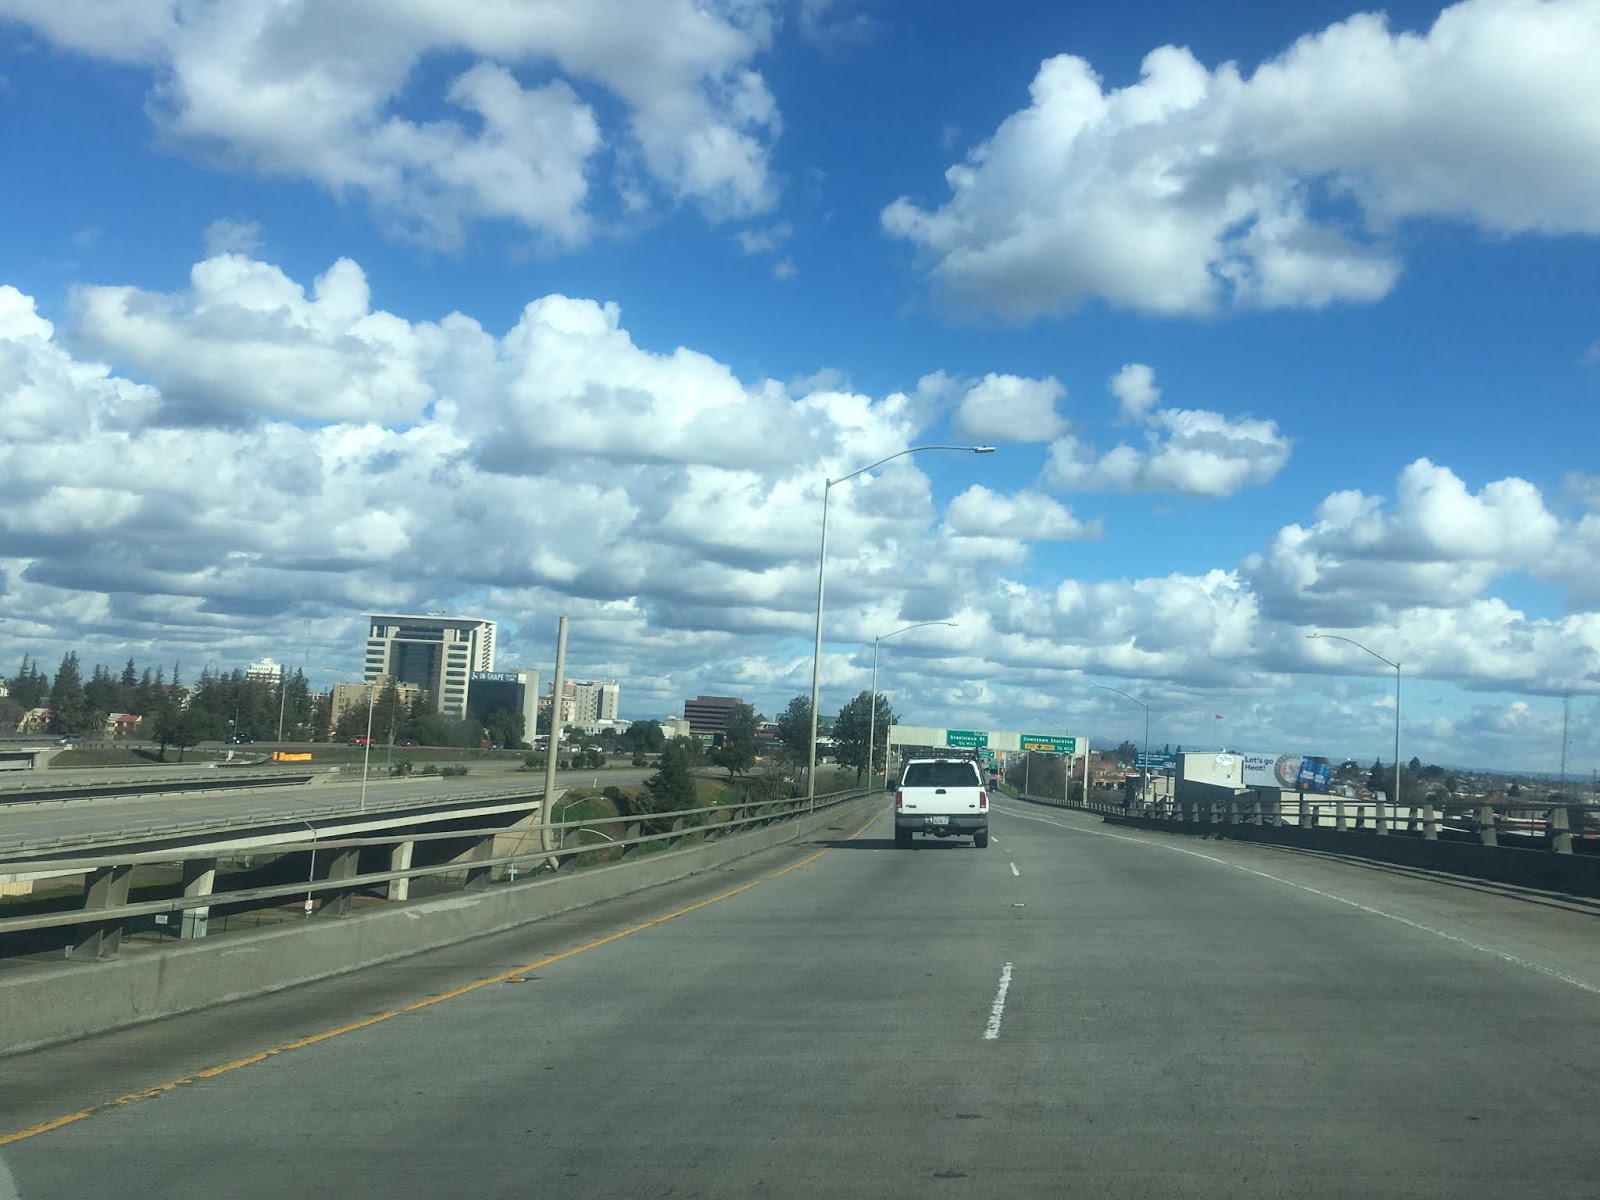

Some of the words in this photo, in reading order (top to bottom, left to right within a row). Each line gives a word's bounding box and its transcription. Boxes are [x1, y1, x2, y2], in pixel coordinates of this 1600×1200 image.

[479, 673, 504, 681] IN-SHAPE
[1245, 756, 1263, 764] Let's
[1264, 758, 1274, 766] go
[1245, 764, 1266, 772] Heat!
